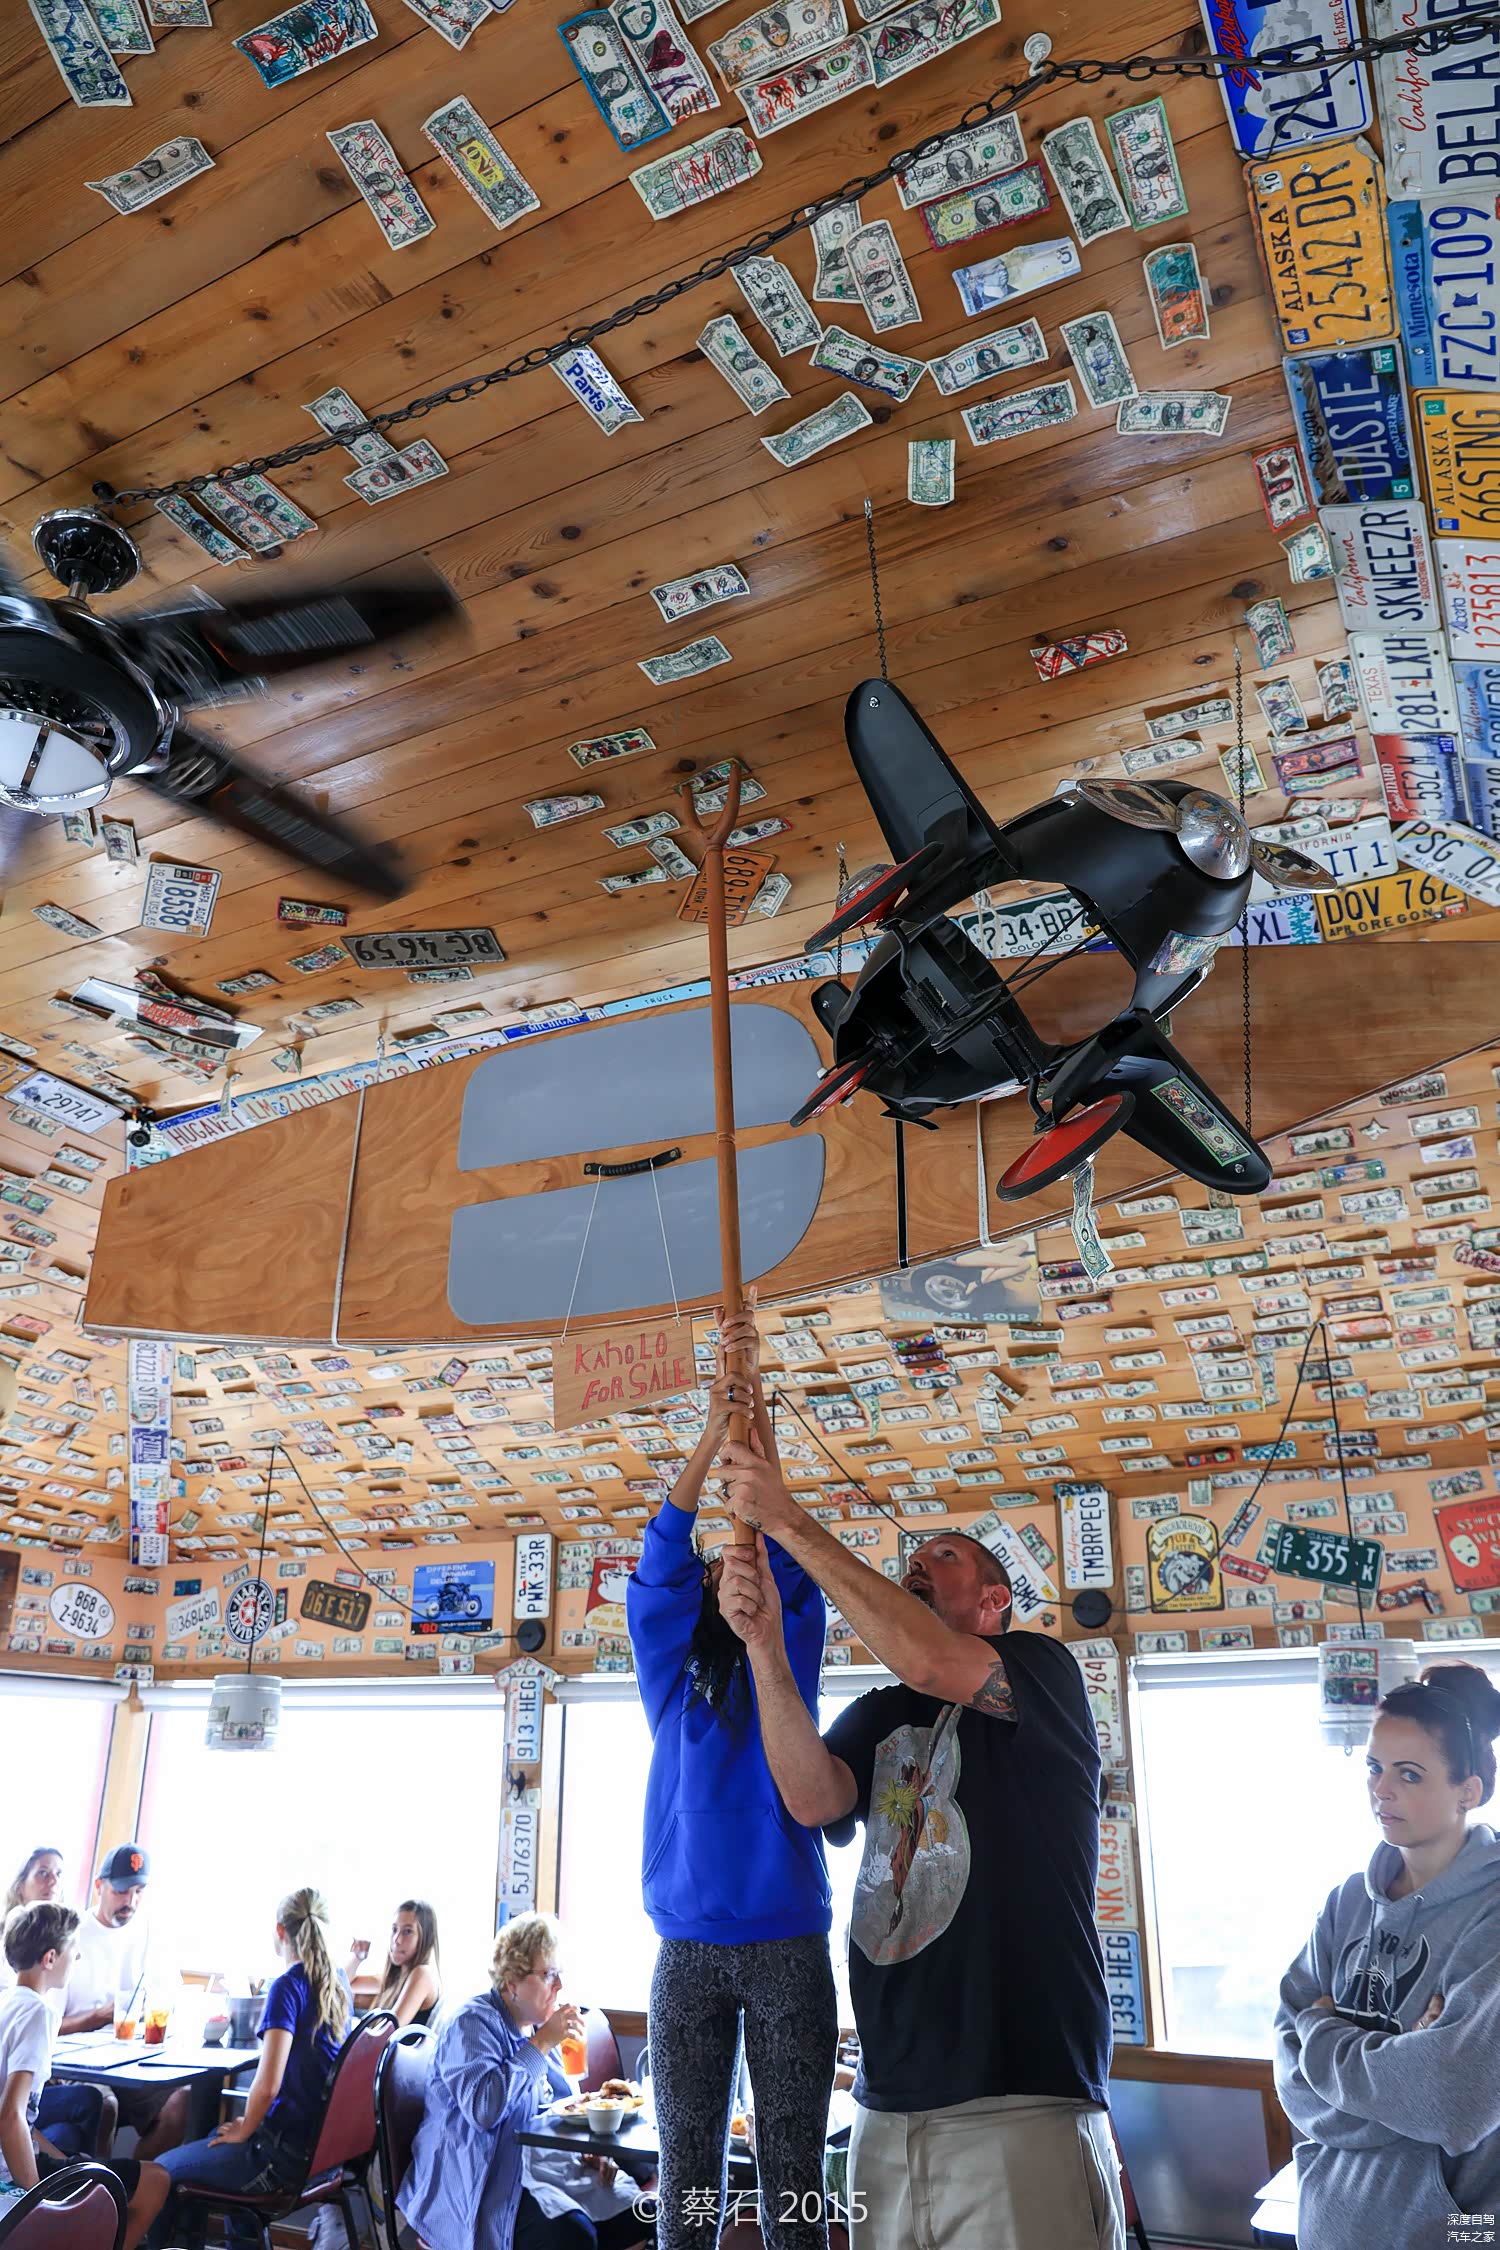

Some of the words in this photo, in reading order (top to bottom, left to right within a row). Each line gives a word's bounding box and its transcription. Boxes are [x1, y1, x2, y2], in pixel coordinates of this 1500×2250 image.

[1269, 205, 1305, 312] ALASKA
[1290, 160, 1371, 330] 2542DR
[1429, 206, 1495, 287] 109
[1405, 252, 1425, 340] Minnesota
[1381, 350, 1393, 367] 14
[1437, 310, 1498, 383] FZC
[565, 361, 607, 413] Parts
[1385, 392, 1401, 422] LAKE
[1301, 409, 1325, 463] Oregon
[1319, 374, 1393, 482] DASIE
[1394, 482, 1409, 495] 5
[1431, 428, 1456, 506] ALASKA
[1344, 530, 1370, 607] California
[1361, 508, 1424, 622] SKWEEZR
[1384, 636, 1433, 679] LXH
[1365, 666, 1383, 705] TEXAS
[1397, 689, 1442, 732] 281
[1397, 820, 1464, 864] PSG
[158, 878, 200, 927] 18538
[1445, 871, 1473, 891] STATE
[1323, 885, 1381, 926] DQV
[1357, 907, 1435, 933] OREGON
[528, 1014, 581, 1033] MICHIGAN
[42, 1092, 104, 1123] 29747
[981, 1312, 1032, 1322] 2012
[628, 1356, 692, 1399] SALE
[1080, 1496, 1105, 1582] TMBRPEG
[1305, 1539, 1350, 1575] 355
[75, 1590, 98, 1613] 868
